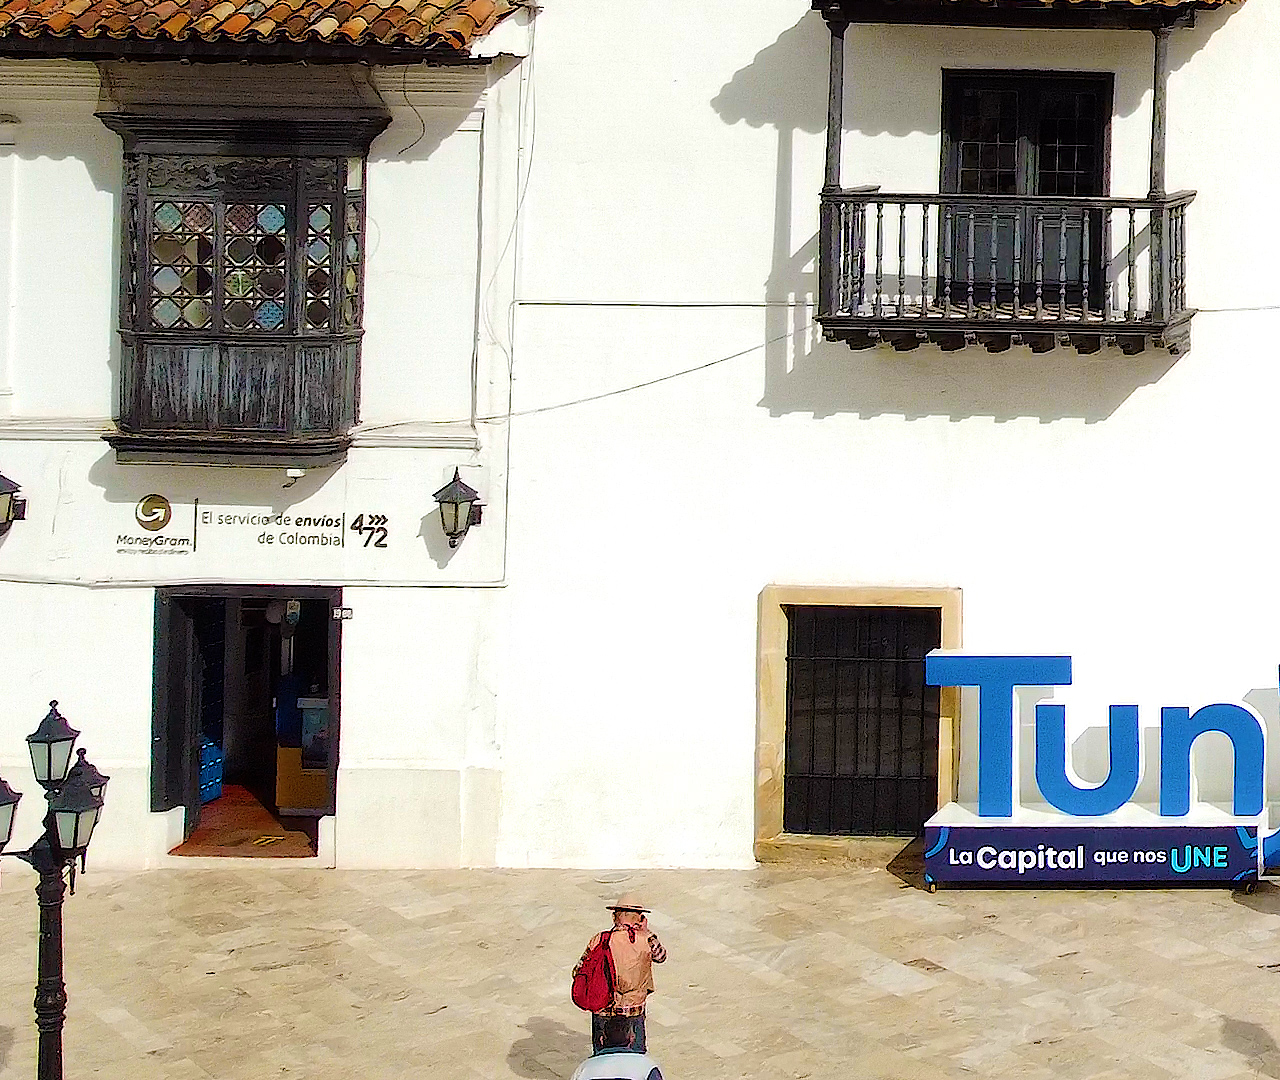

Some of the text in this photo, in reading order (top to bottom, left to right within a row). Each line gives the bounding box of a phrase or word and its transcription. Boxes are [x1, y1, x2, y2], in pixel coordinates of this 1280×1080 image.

[201, 511, 214, 526] El
[218, 512, 268, 526] servicio
[275, 512, 291, 526] de
[257, 531, 341, 547] de Colombia
[949, 844, 1229, 875] La Capital que nos UNE
